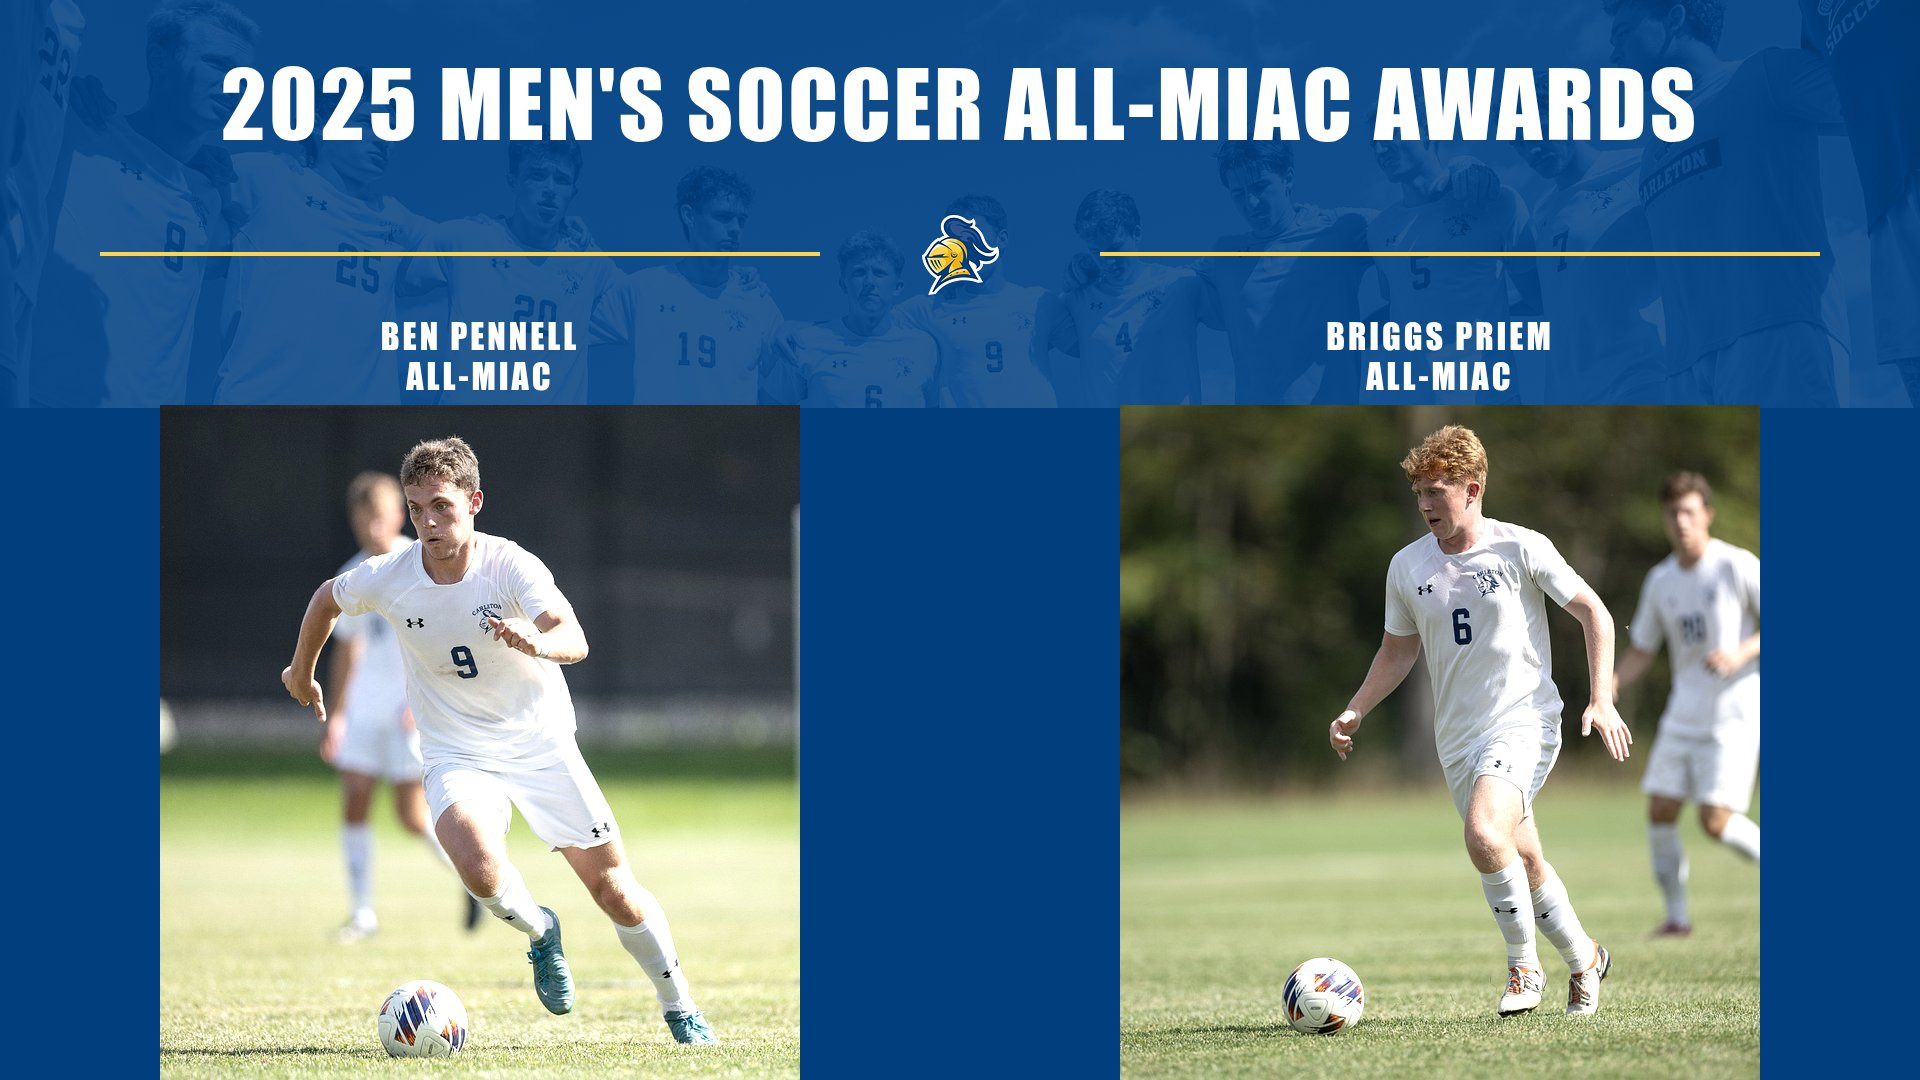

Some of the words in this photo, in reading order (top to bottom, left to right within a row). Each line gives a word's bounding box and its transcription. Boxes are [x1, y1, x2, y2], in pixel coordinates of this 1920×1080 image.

[1640, 148, 1708, 203] ARLETON
[164, 220, 186, 273] 8
[1553, 229, 1568, 273] 7
[336, 242, 381, 294] 25
[1409, 252, 1431, 290] 5
[677, 331, 717, 368] 19
[1115, 321, 1133, 352] 4
[985, 341, 1003, 373] 9
[1452, 608, 1472, 645] 6
[450, 646, 478, 679] 9
